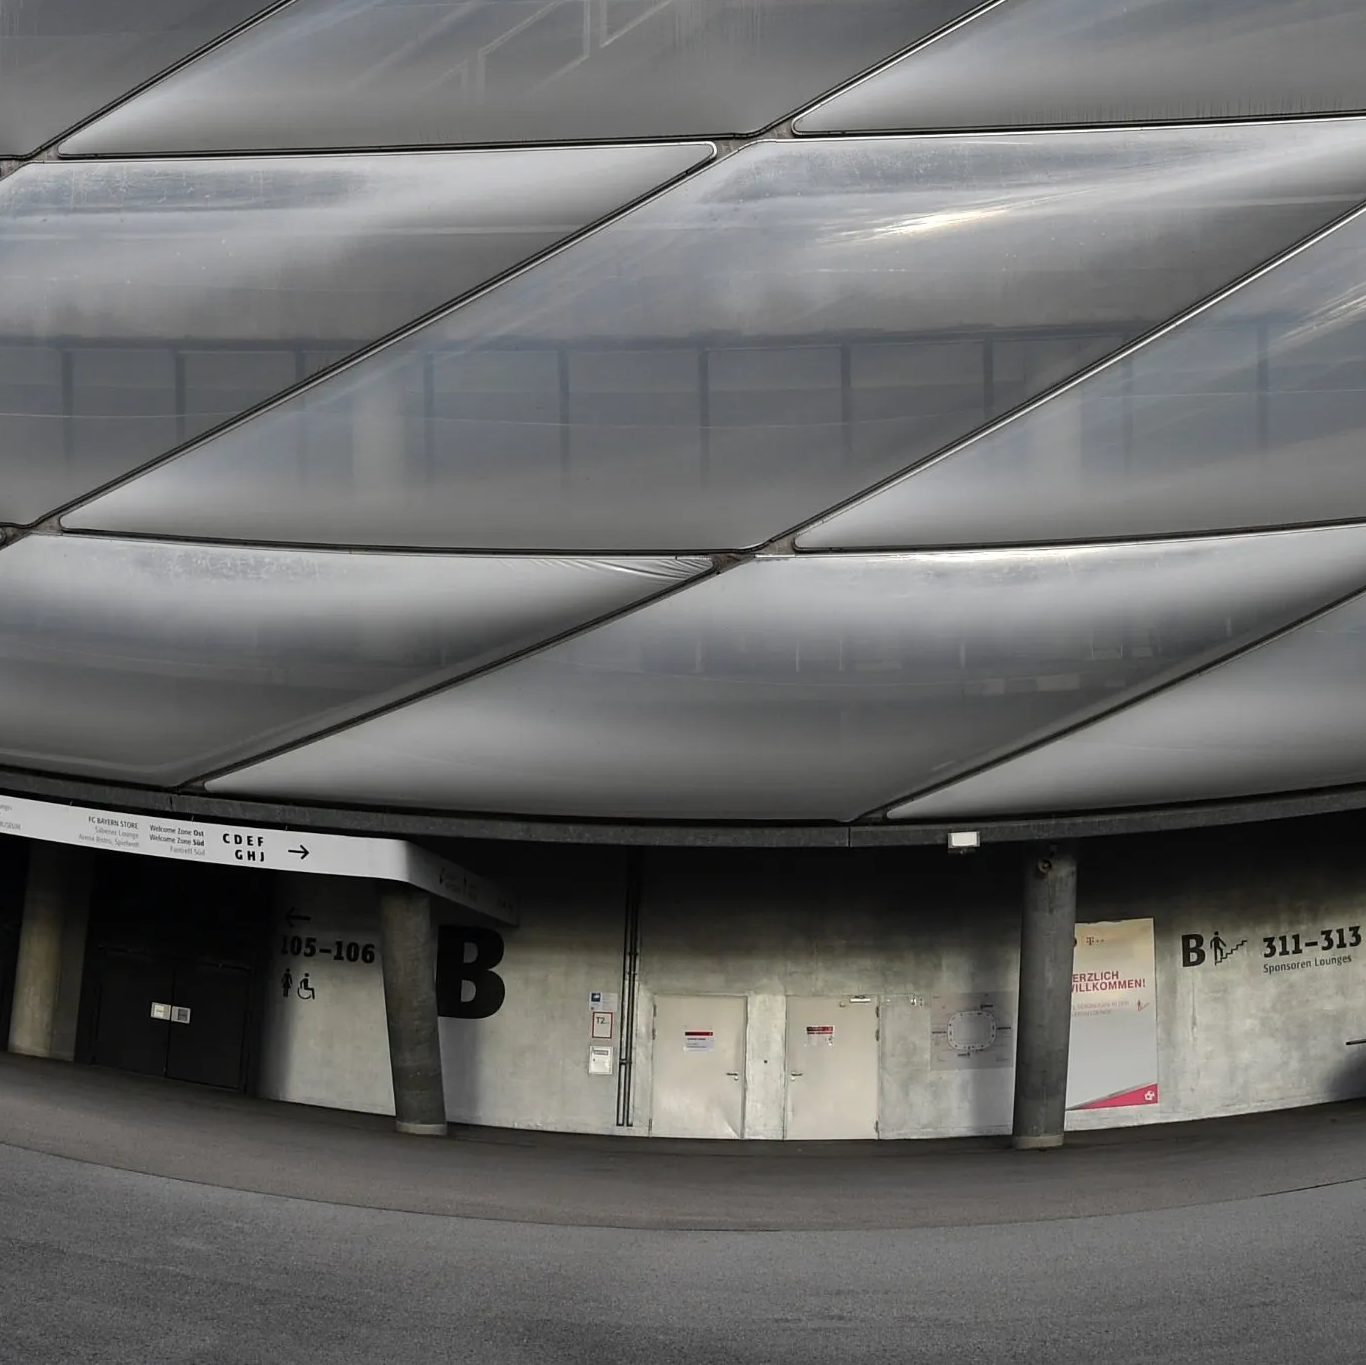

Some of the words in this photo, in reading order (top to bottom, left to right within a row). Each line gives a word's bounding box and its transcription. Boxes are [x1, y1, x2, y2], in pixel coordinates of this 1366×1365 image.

[88, 816, 95, 824] FC
[96, 817, 119, 827] BAYERN
[119, 820, 139, 830] STORE
[149, 823, 176, 834] Welcome
[177, 827, 192, 836] Zone
[193, 829, 205, 837] Ost
[149, 834, 176, 844] Welcome
[177, 837, 191, 845] Zone
[193, 839, 205, 847] Süd
[280, 934, 375, 963] 105-106
[1181, 933, 1206, 968] B
[1262, 925, 1362, 959] 311-313
[435, 925, 505, 1019] B
[1263, 959, 1312, 975] Sponsoren
[1314, 954, 1352, 968] Lounges
[1071, 971, 1120, 984] ERZLICH
